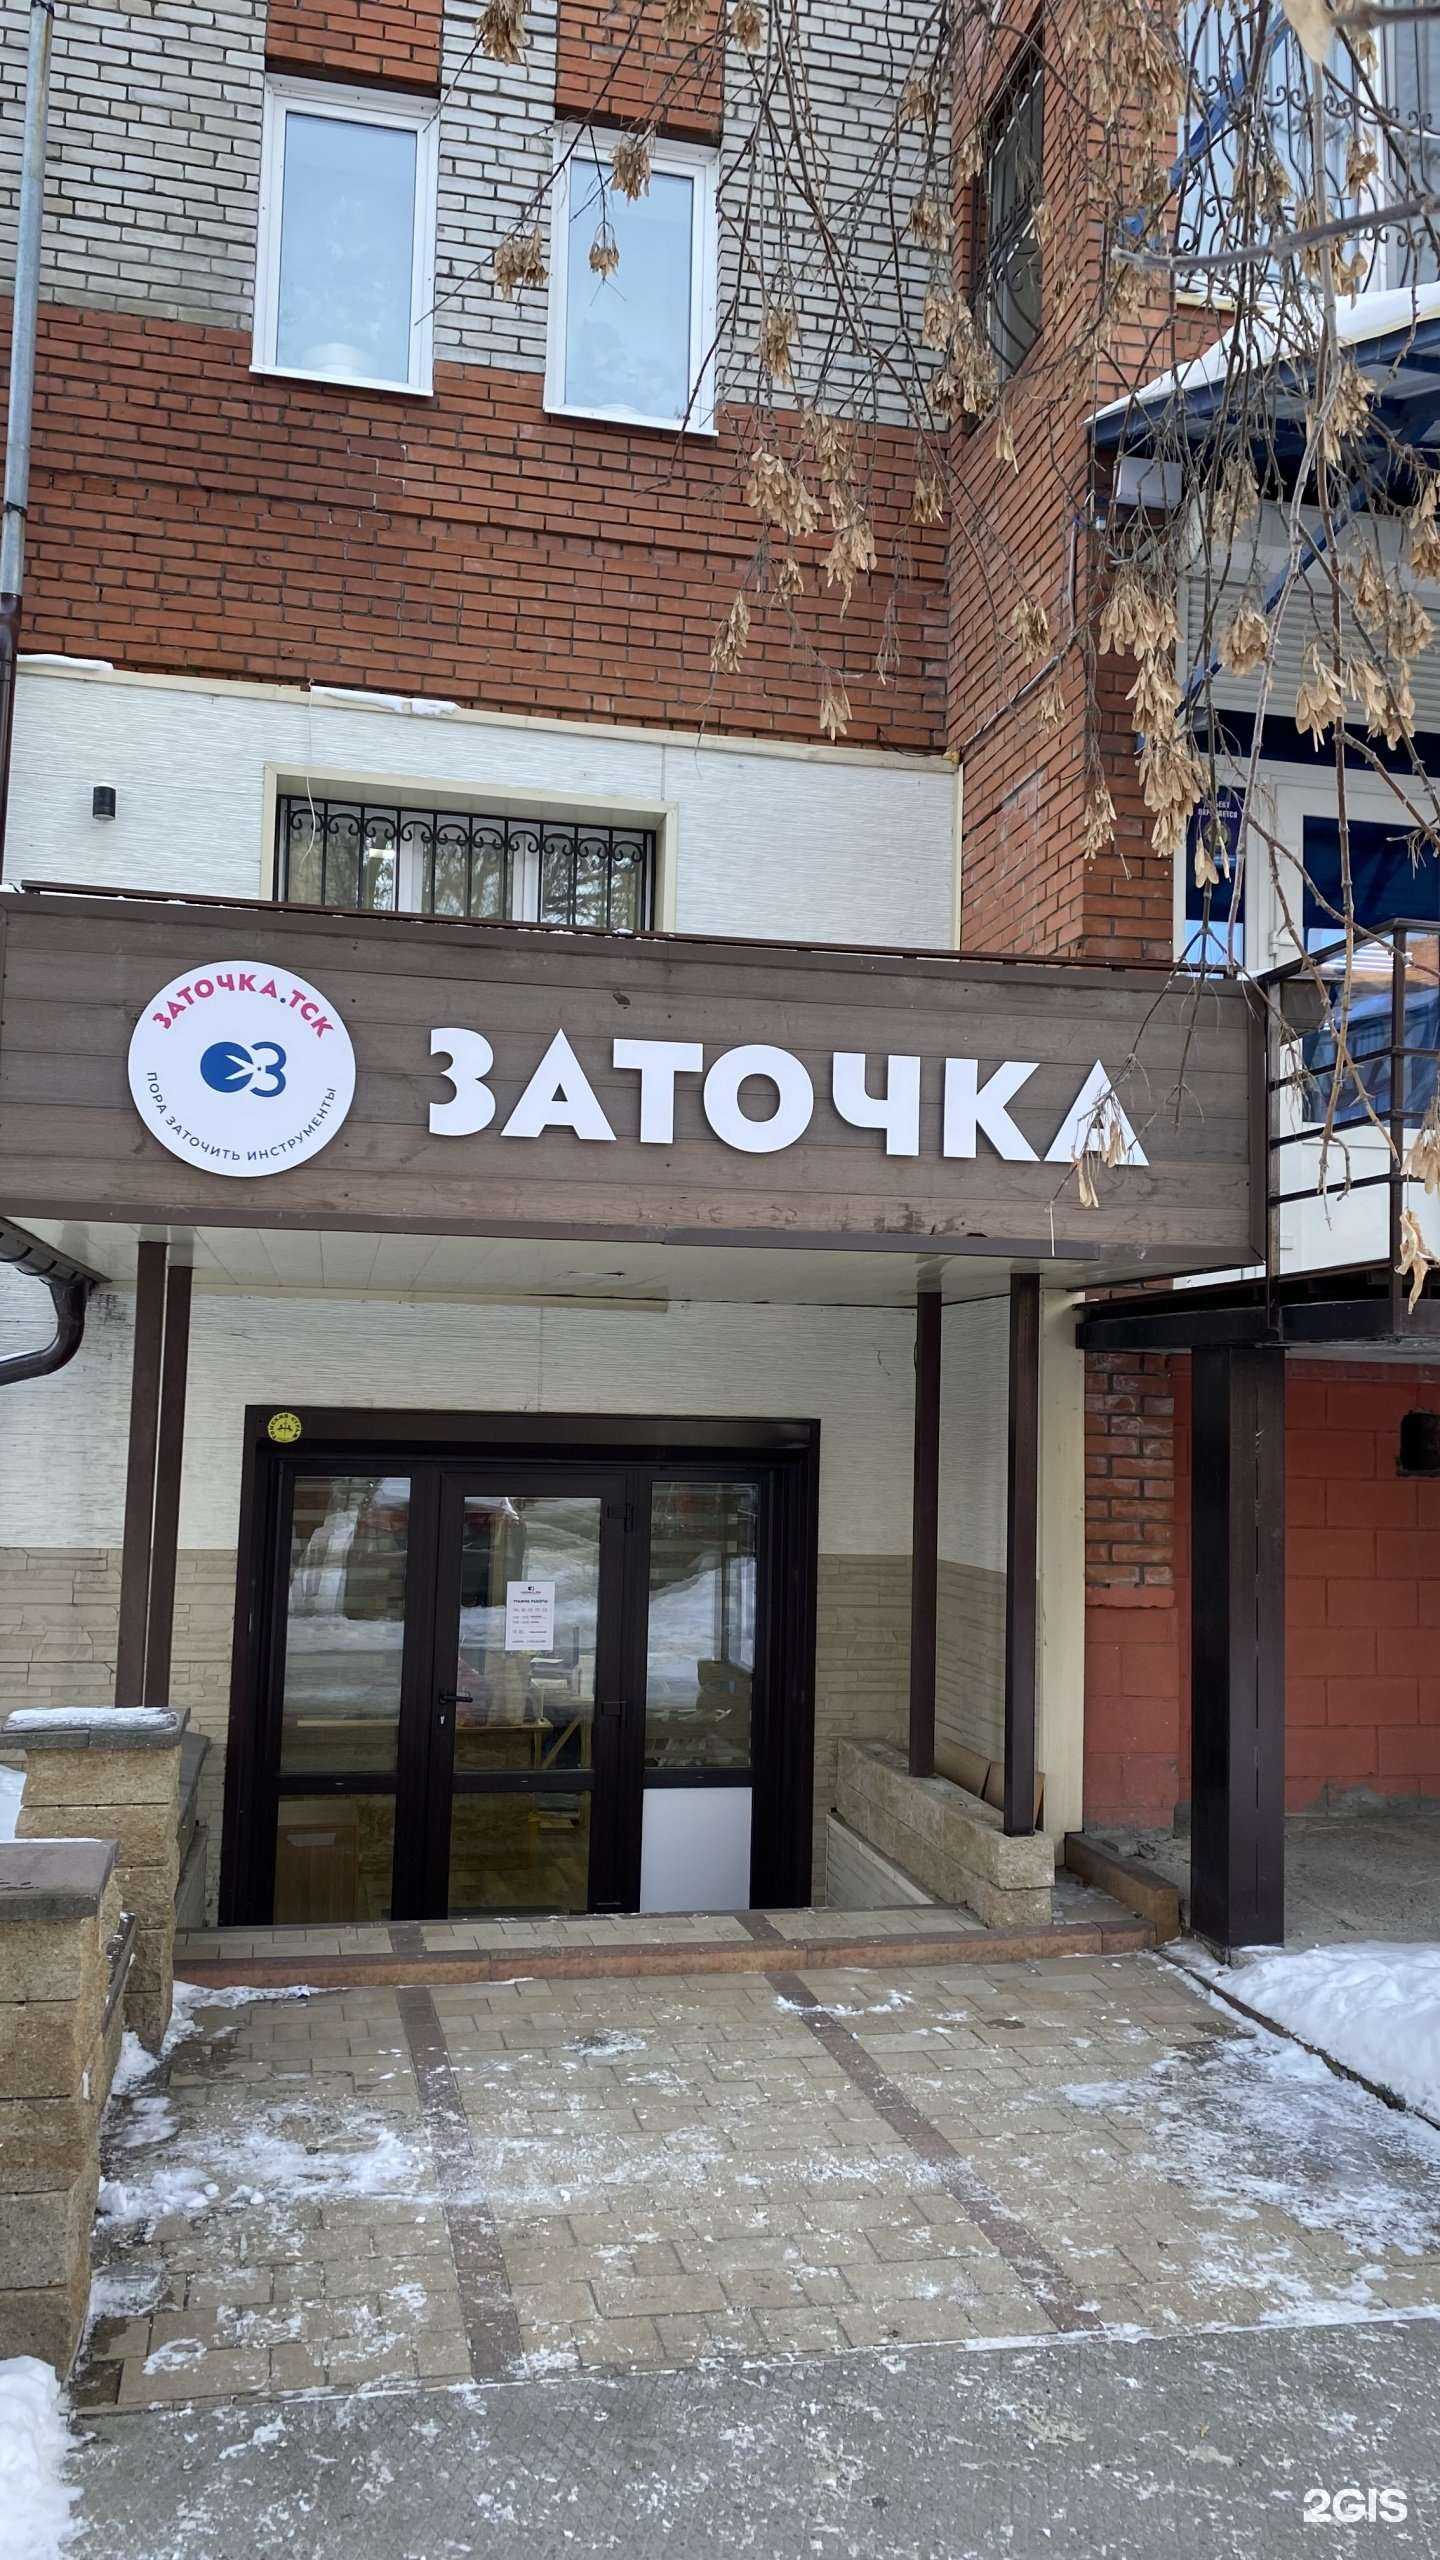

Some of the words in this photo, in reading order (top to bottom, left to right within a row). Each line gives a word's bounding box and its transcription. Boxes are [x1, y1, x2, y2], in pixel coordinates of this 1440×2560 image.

[151, 973, 334, 1038] ЗАТОЧКА.ТСК
[146, 1071, 168, 1114] ПОРА
[165, 1115, 241, 1162] ЗАТОЧИТЬ
[246, 1087, 337, 1162] ИНСТРУМЕНТЫ
[428, 1026, 1150, 1167] ЗАТОЧКА
